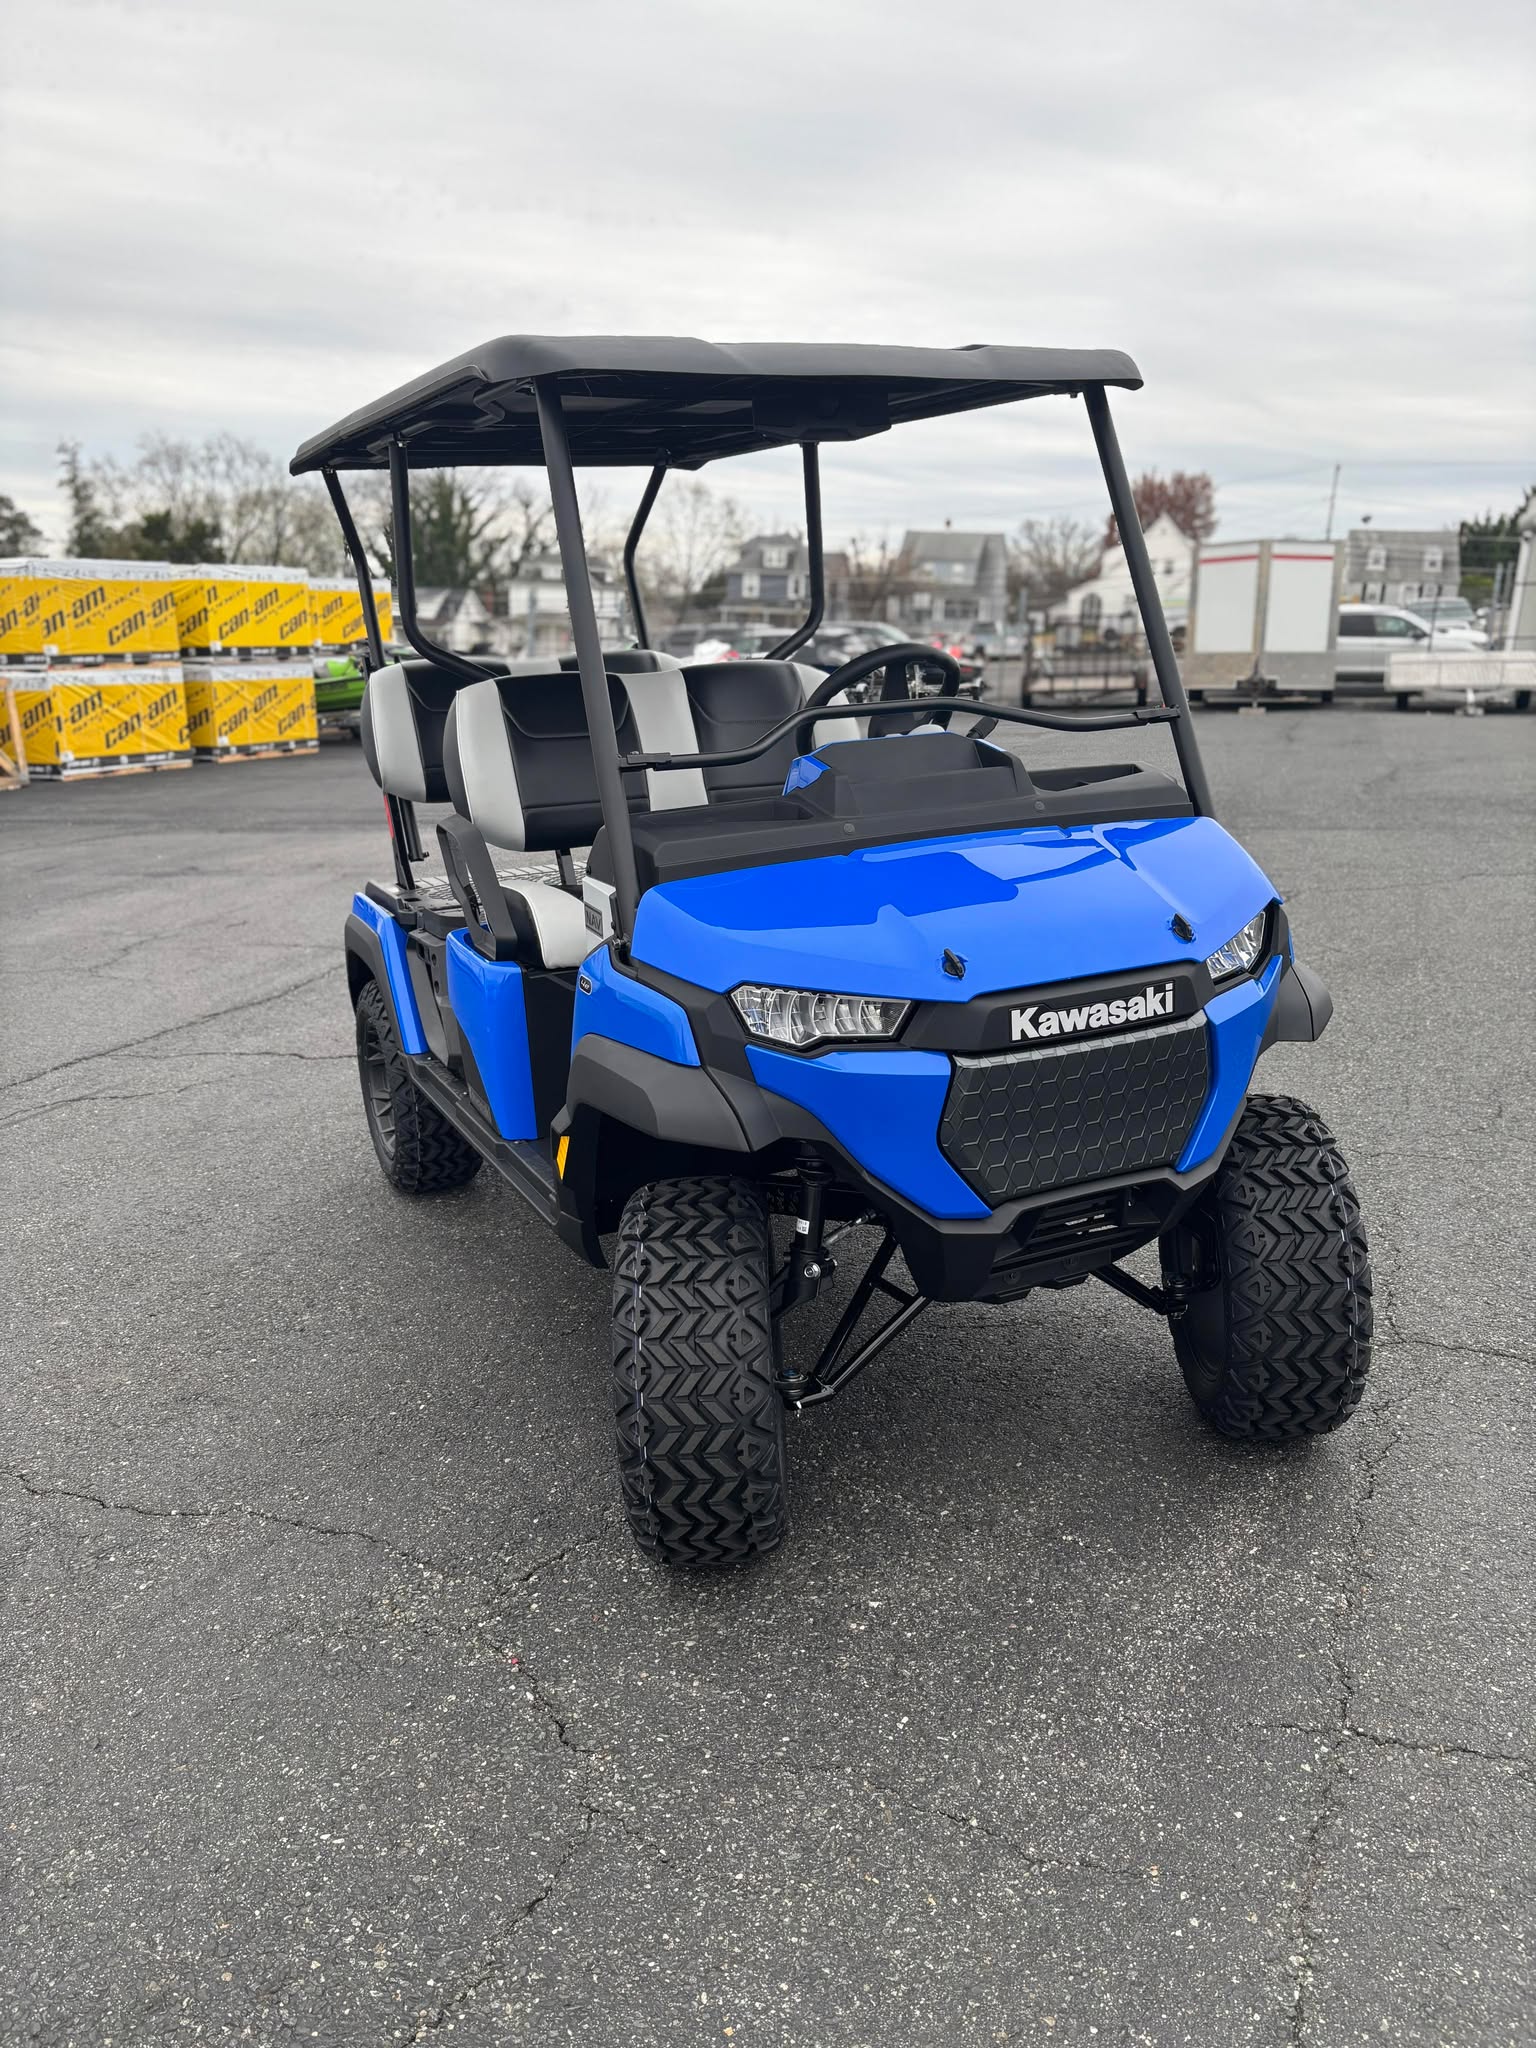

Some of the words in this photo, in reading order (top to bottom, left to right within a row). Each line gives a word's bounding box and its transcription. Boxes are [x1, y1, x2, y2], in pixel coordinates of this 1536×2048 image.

[218, 588, 279, 640] can-am
[105, 688, 178, 749] can-am
[1011, 982, 1174, 1041] Kawasaki
